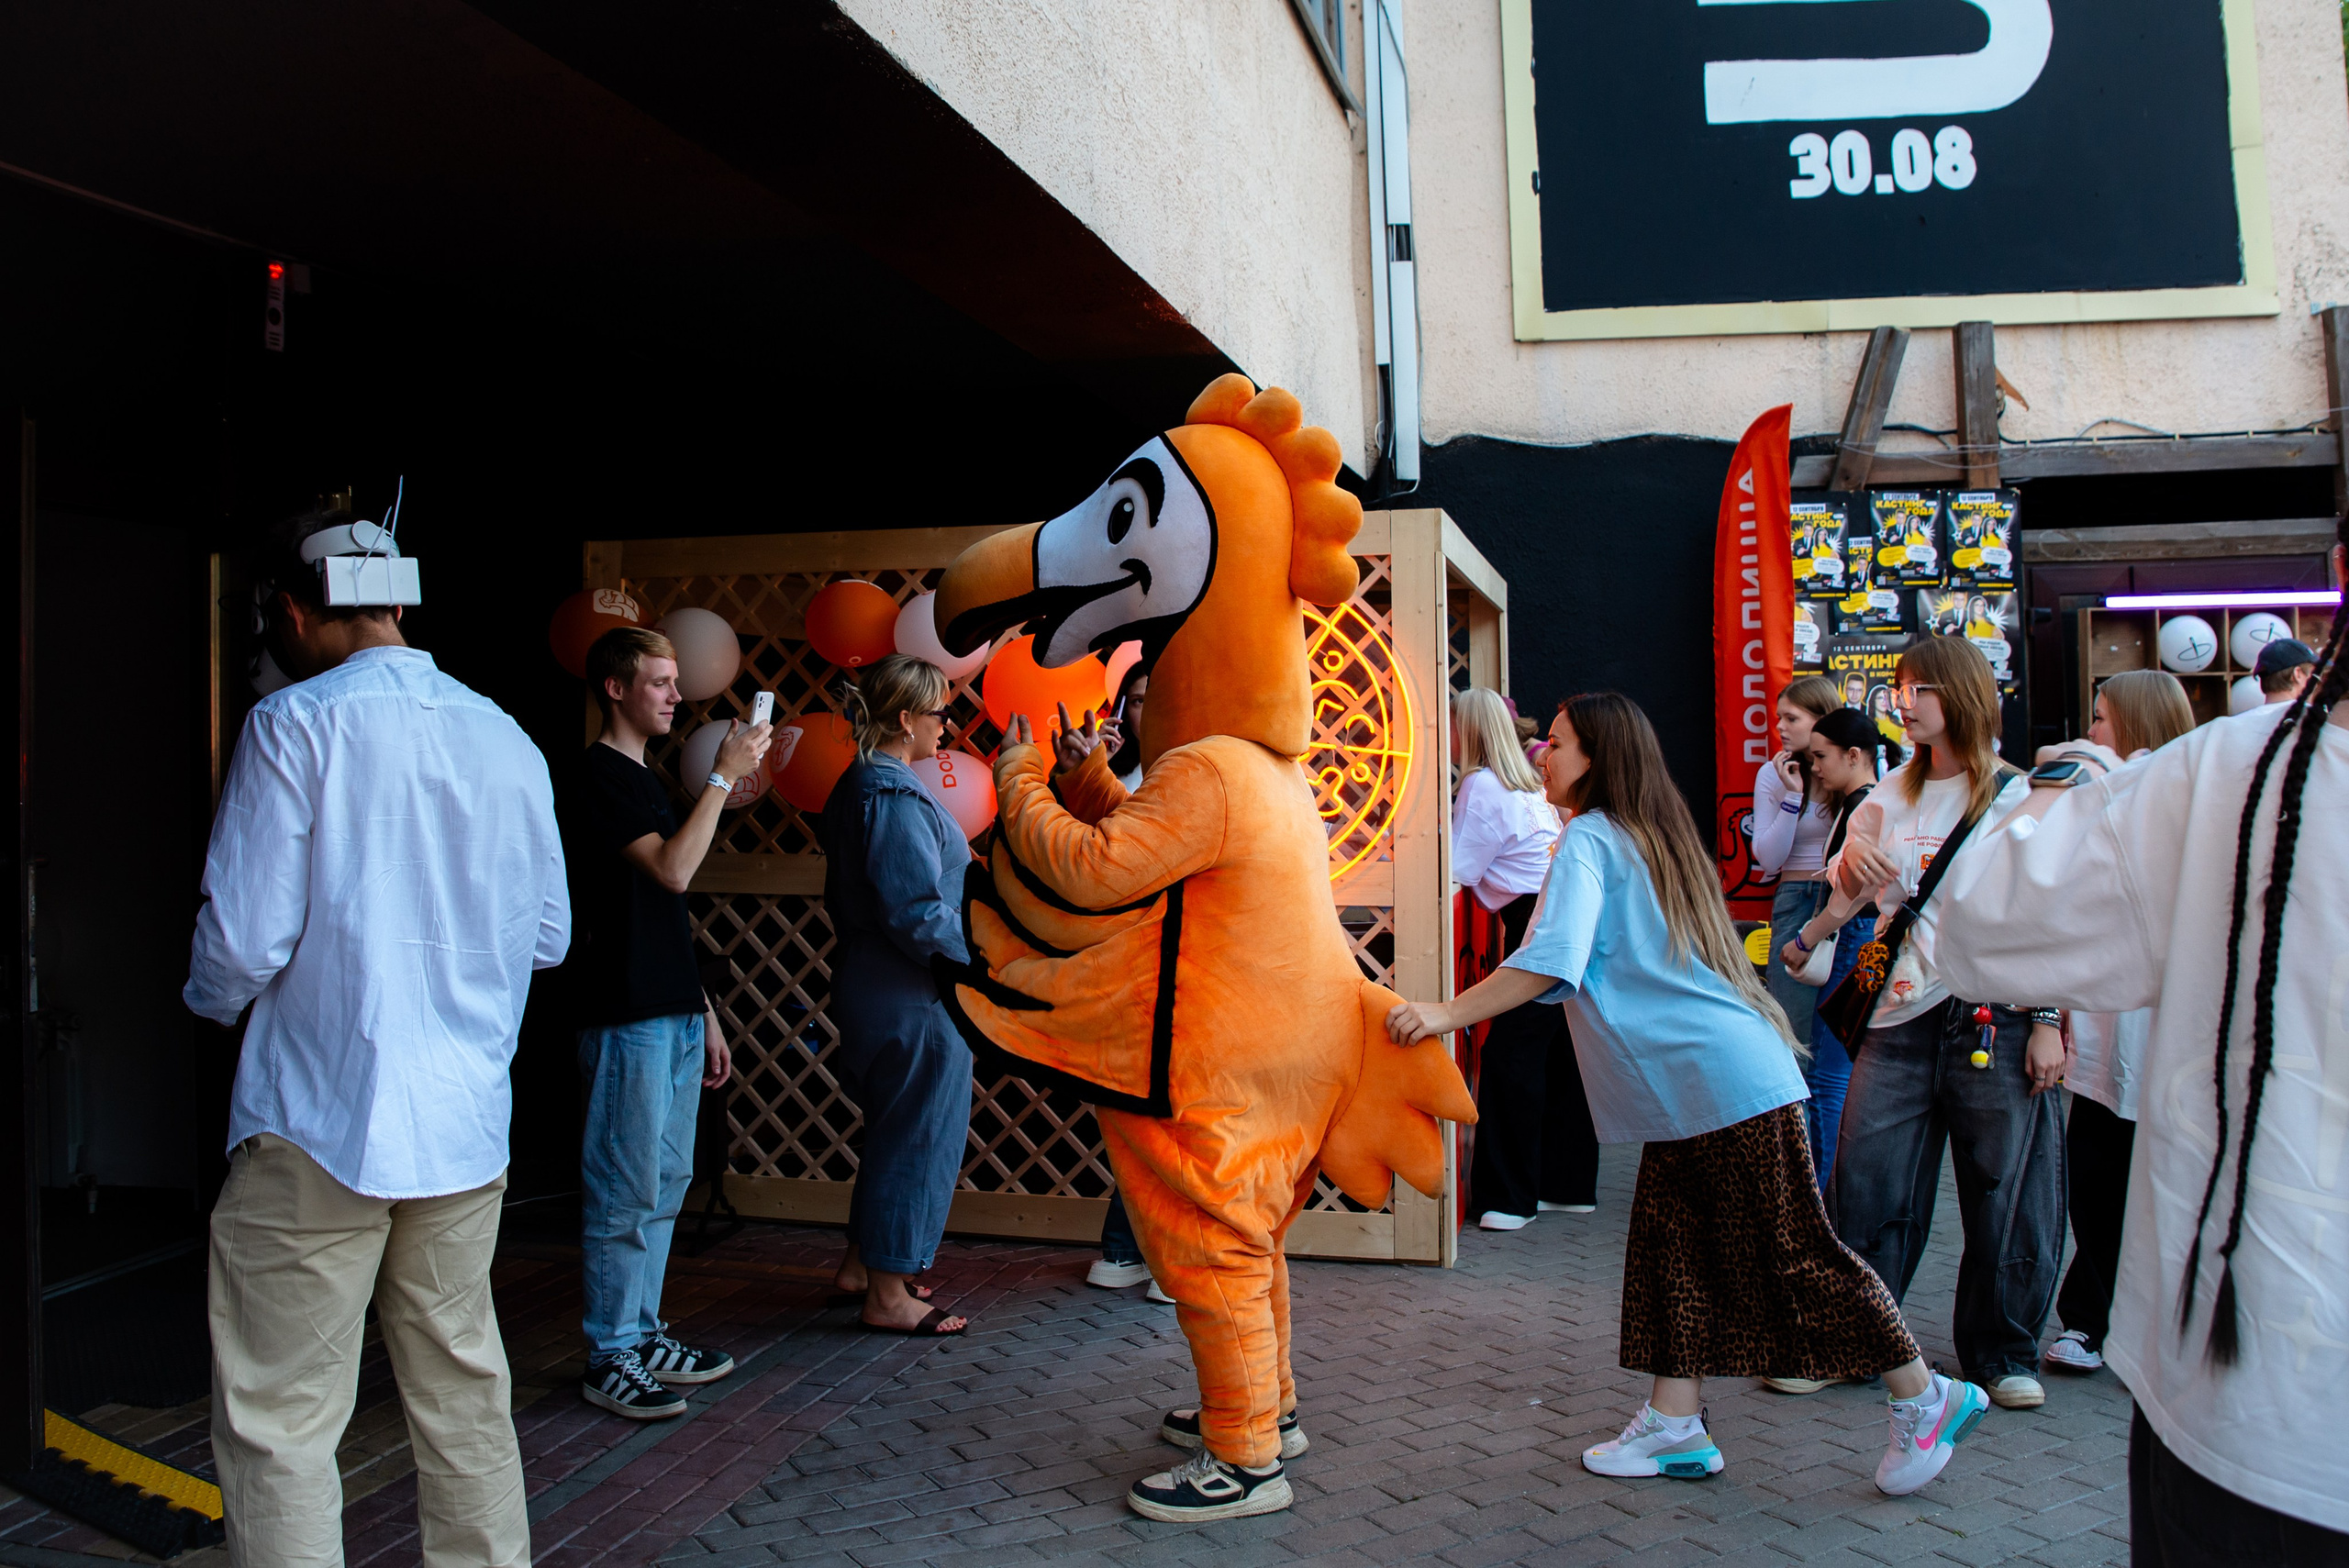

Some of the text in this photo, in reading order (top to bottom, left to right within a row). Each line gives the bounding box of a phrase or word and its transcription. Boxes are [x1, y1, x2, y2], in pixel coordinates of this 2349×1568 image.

[1789, 125, 1977, 198] 30.08
[1876, 500, 1926, 508] КАСТИНГ
[1952, 502, 2002, 510] КАСТИНГ
[1906, 507, 1935, 516] ГОДА
[1982, 509, 2011, 518] ГОДА
[1790, 512, 1833, 521] АСТИНГ
[1813, 519, 1842, 528] ГОДА
[936, 750, 957, 788] DOD
